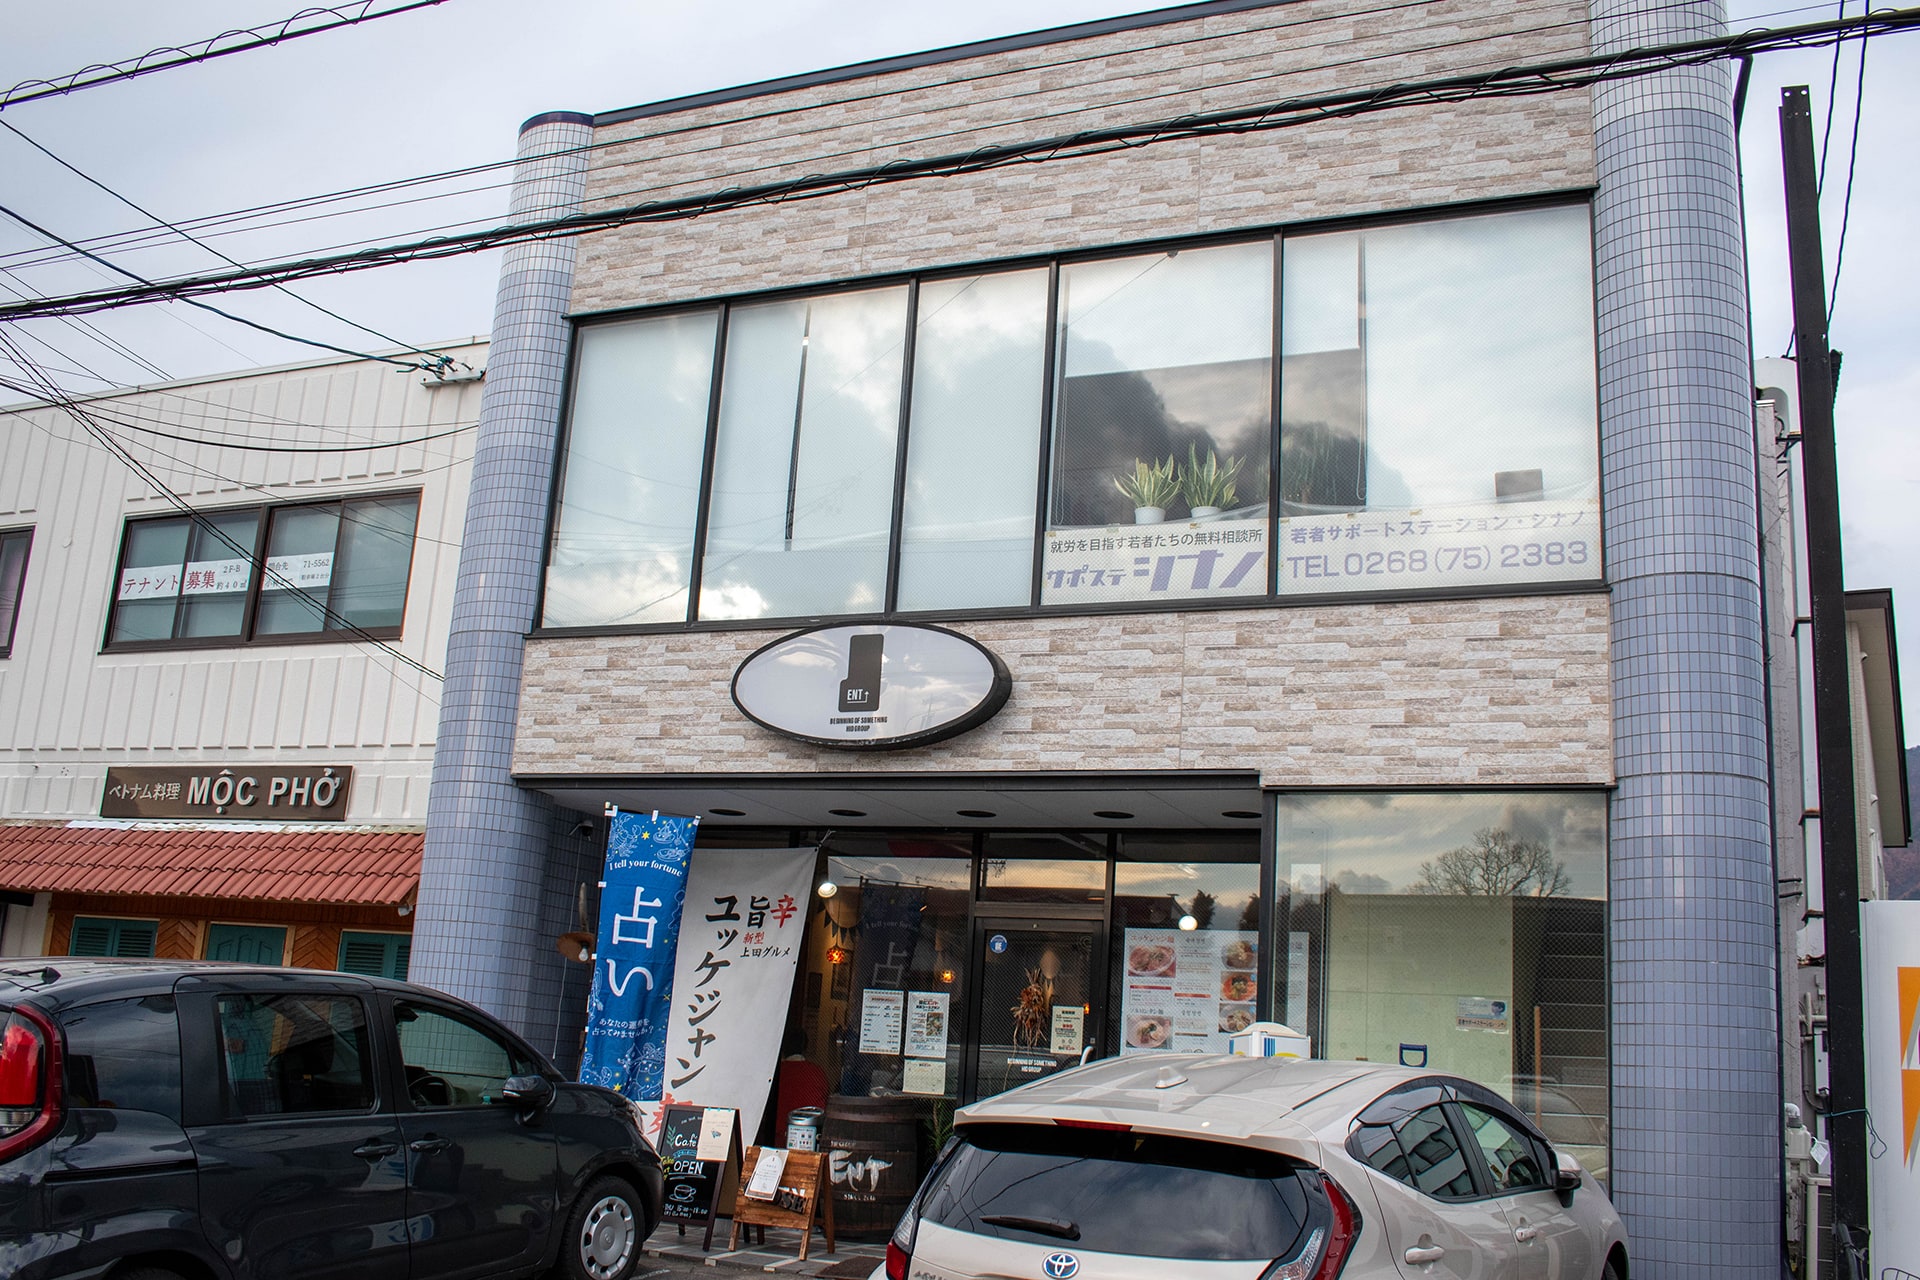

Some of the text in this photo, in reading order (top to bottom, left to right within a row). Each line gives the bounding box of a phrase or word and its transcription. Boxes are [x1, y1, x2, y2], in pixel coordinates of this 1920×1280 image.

[1050, 528, 1263, 554] 就労を目指す若者たちの無料相談所
[303, 558, 330, 569] 71-5562
[124, 569, 216, 595] テナント 募集
[847, 689, 864, 701] ENT
[108, 782, 181, 800] ベトナム料理
[186, 767, 343, 815] MỘC PHỞ
[609, 859, 683, 877] I tell your fortune
[605, 885, 663, 998] 占い
[740, 945, 791, 958] 上田グルメ
[671, 894, 741, 1090] ユッケジャン
[673, 1160, 704, 1175] OPEN
